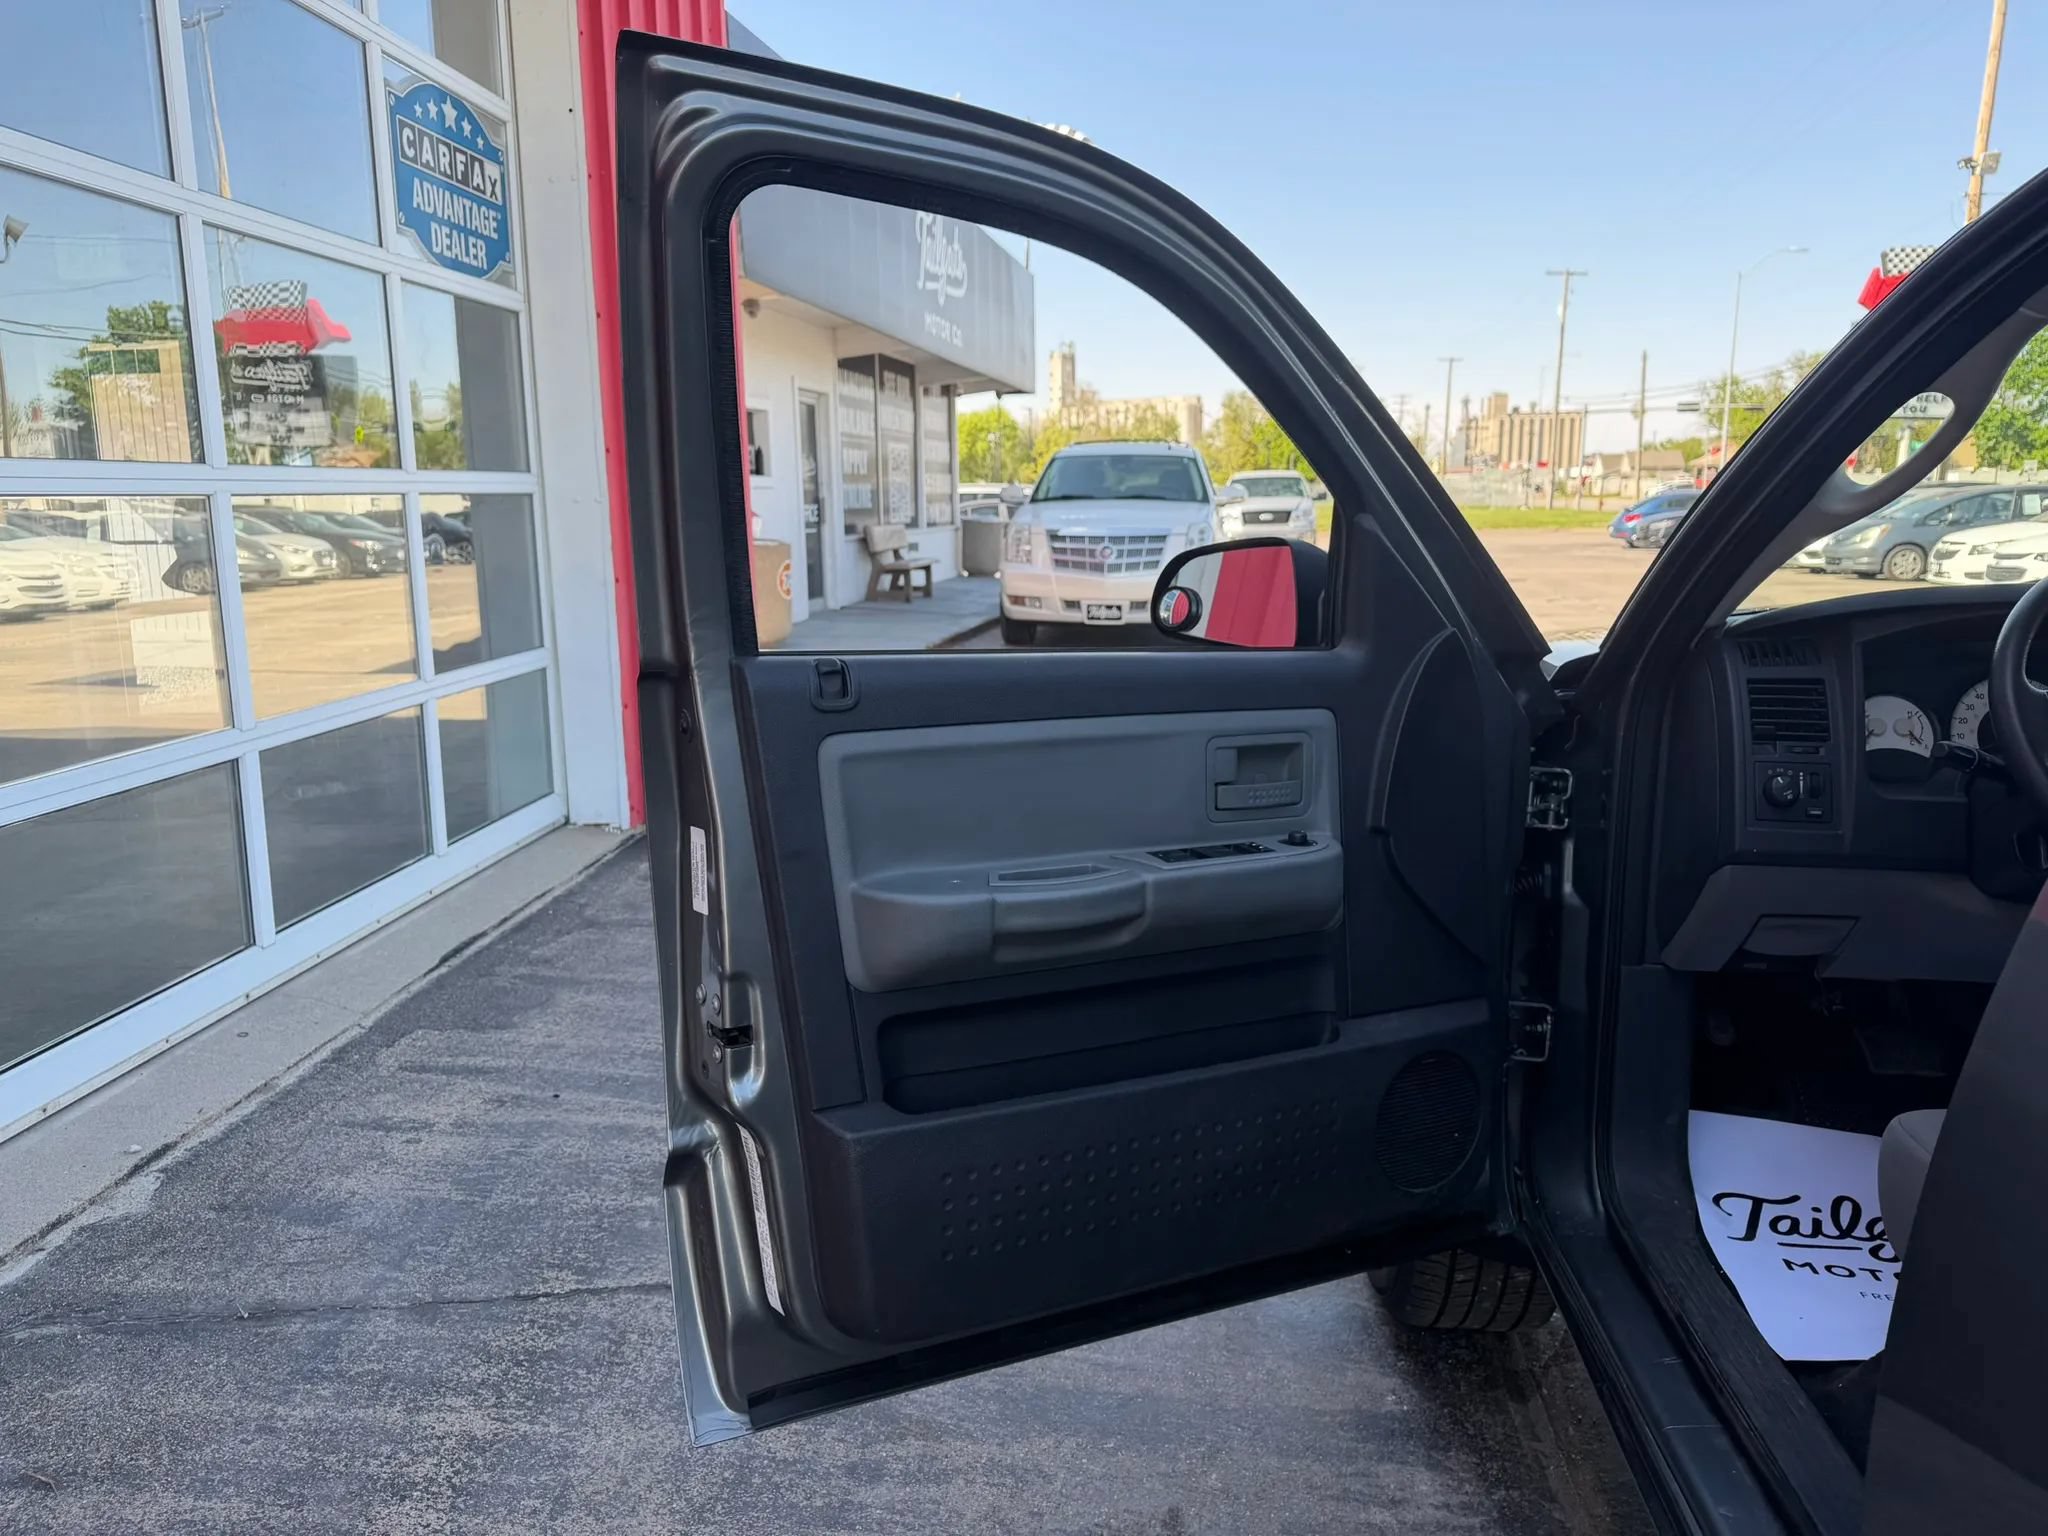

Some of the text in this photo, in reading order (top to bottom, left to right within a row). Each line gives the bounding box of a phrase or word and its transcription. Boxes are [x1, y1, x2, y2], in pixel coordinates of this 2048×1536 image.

[401, 126, 499, 201] CARFAX
[412, 176, 499, 241] ADVANTAGE
[430, 220, 488, 271] DEALER
[1958, 717, 1968, 725] 20
